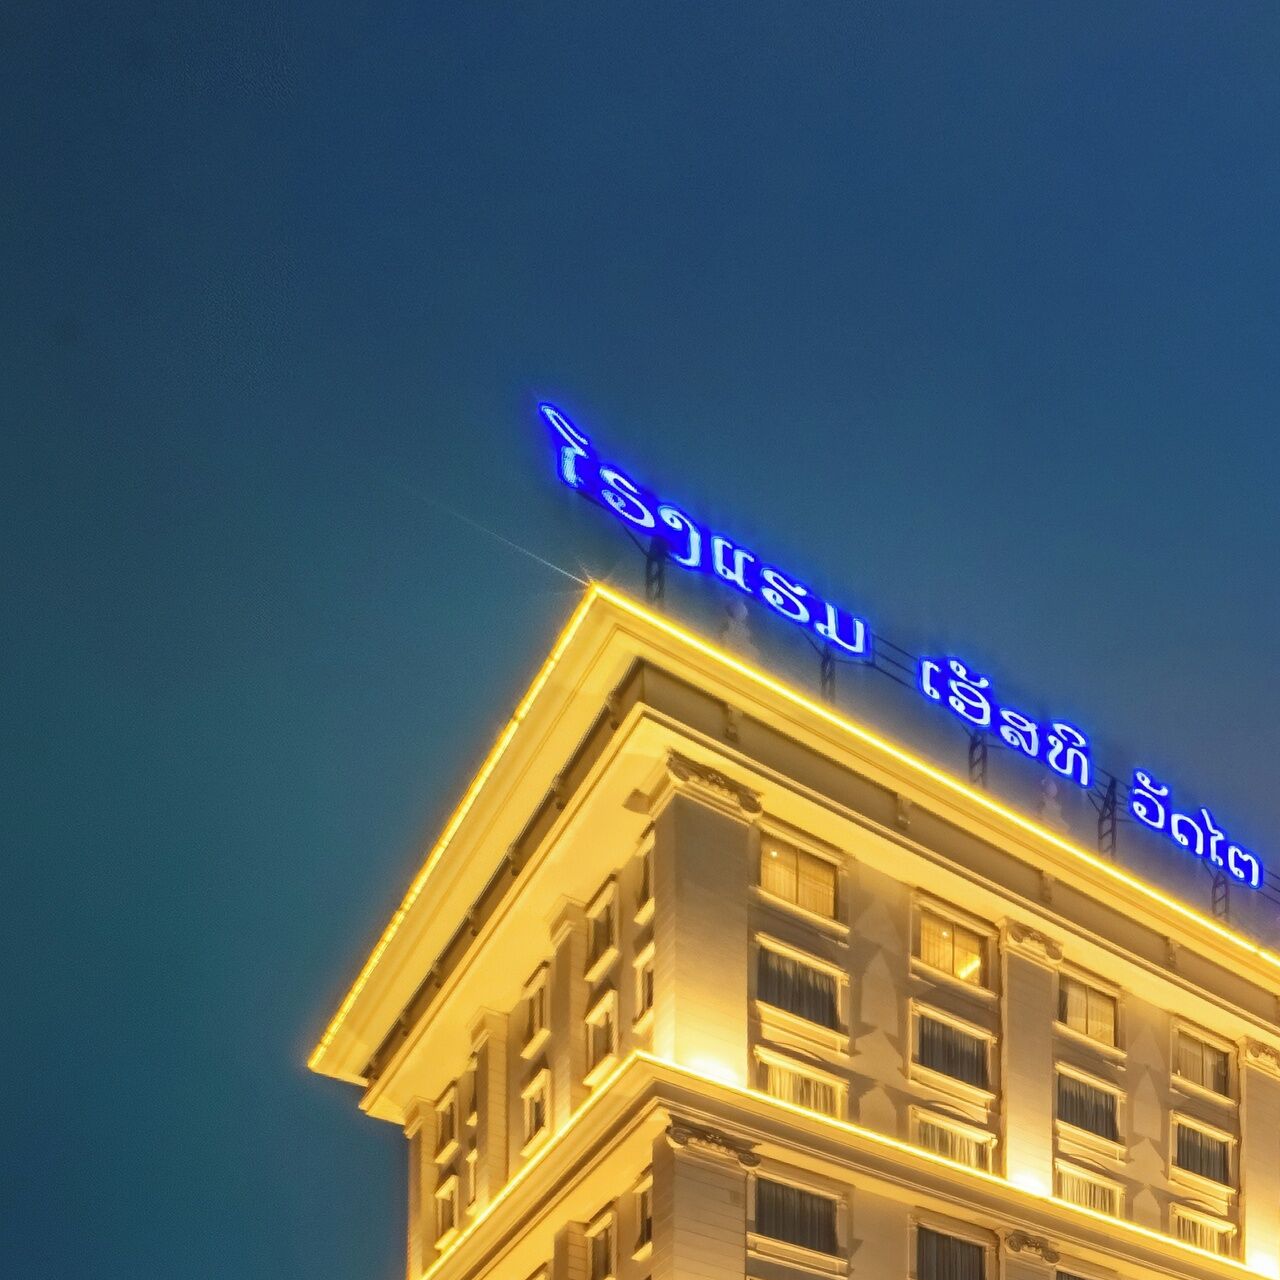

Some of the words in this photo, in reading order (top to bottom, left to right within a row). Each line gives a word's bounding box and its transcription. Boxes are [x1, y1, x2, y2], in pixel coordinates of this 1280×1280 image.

[539, 403, 867, 656] ໂຮງແຮມ
[1132, 770, 1258, 887] ວັດໄຕ
